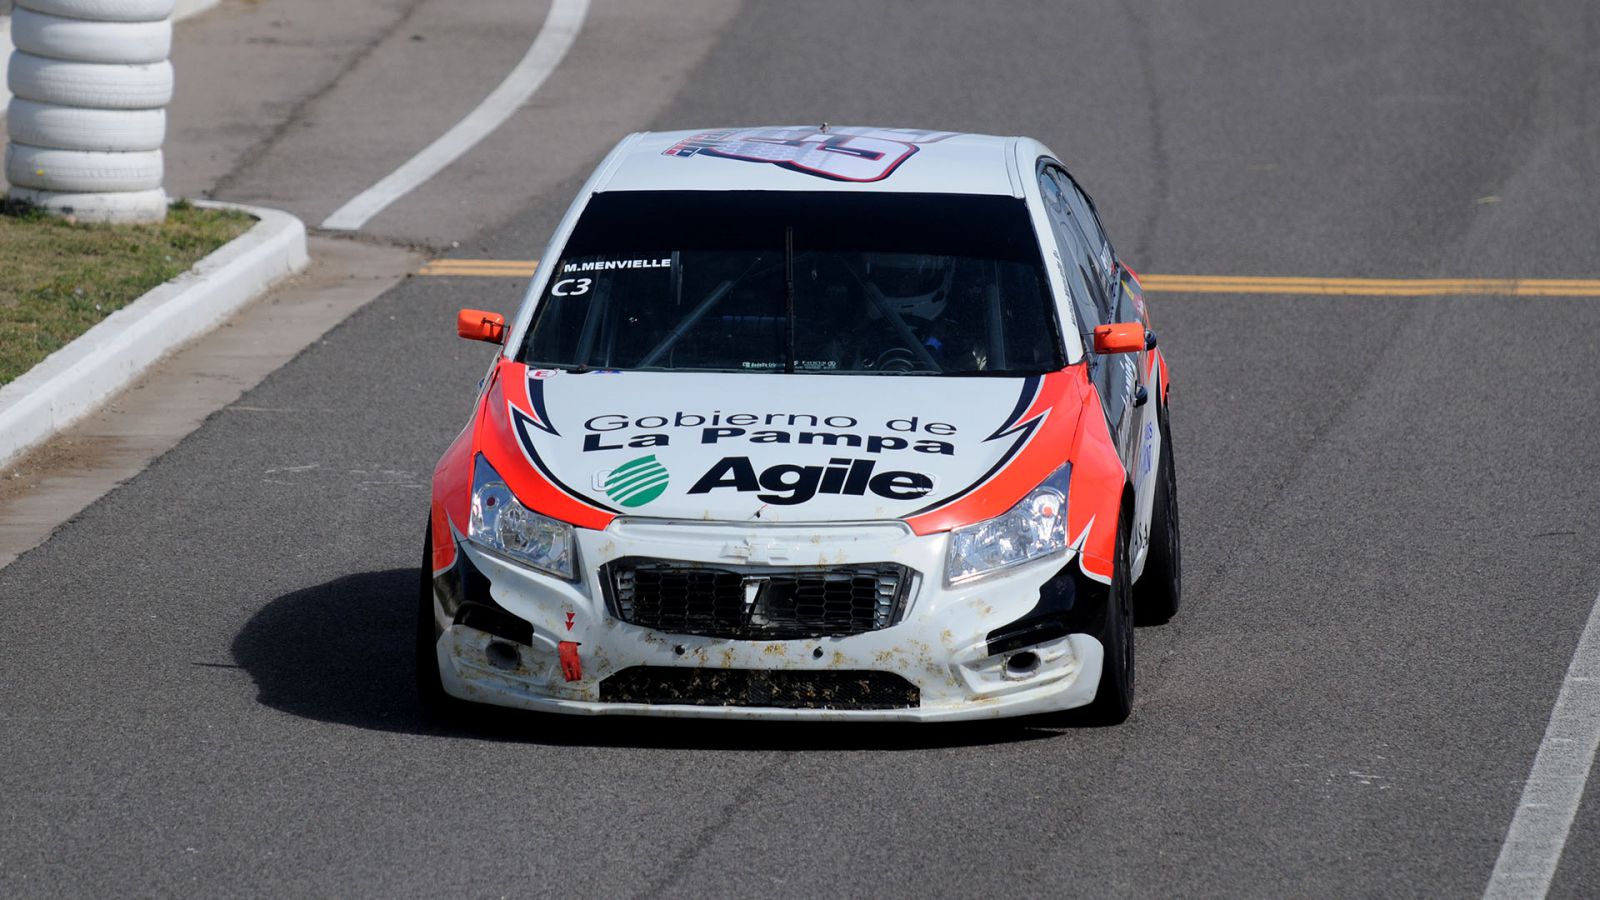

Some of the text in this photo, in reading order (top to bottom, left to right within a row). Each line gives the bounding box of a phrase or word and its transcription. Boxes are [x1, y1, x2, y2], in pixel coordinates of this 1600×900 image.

[564, 258, 672, 273] M.MENVIELLE
[551, 277, 592, 297] C3
[584, 410, 957, 436] Gobierno de
[583, 427, 955, 456] La Pampa
[687, 456, 934, 505] Agile
